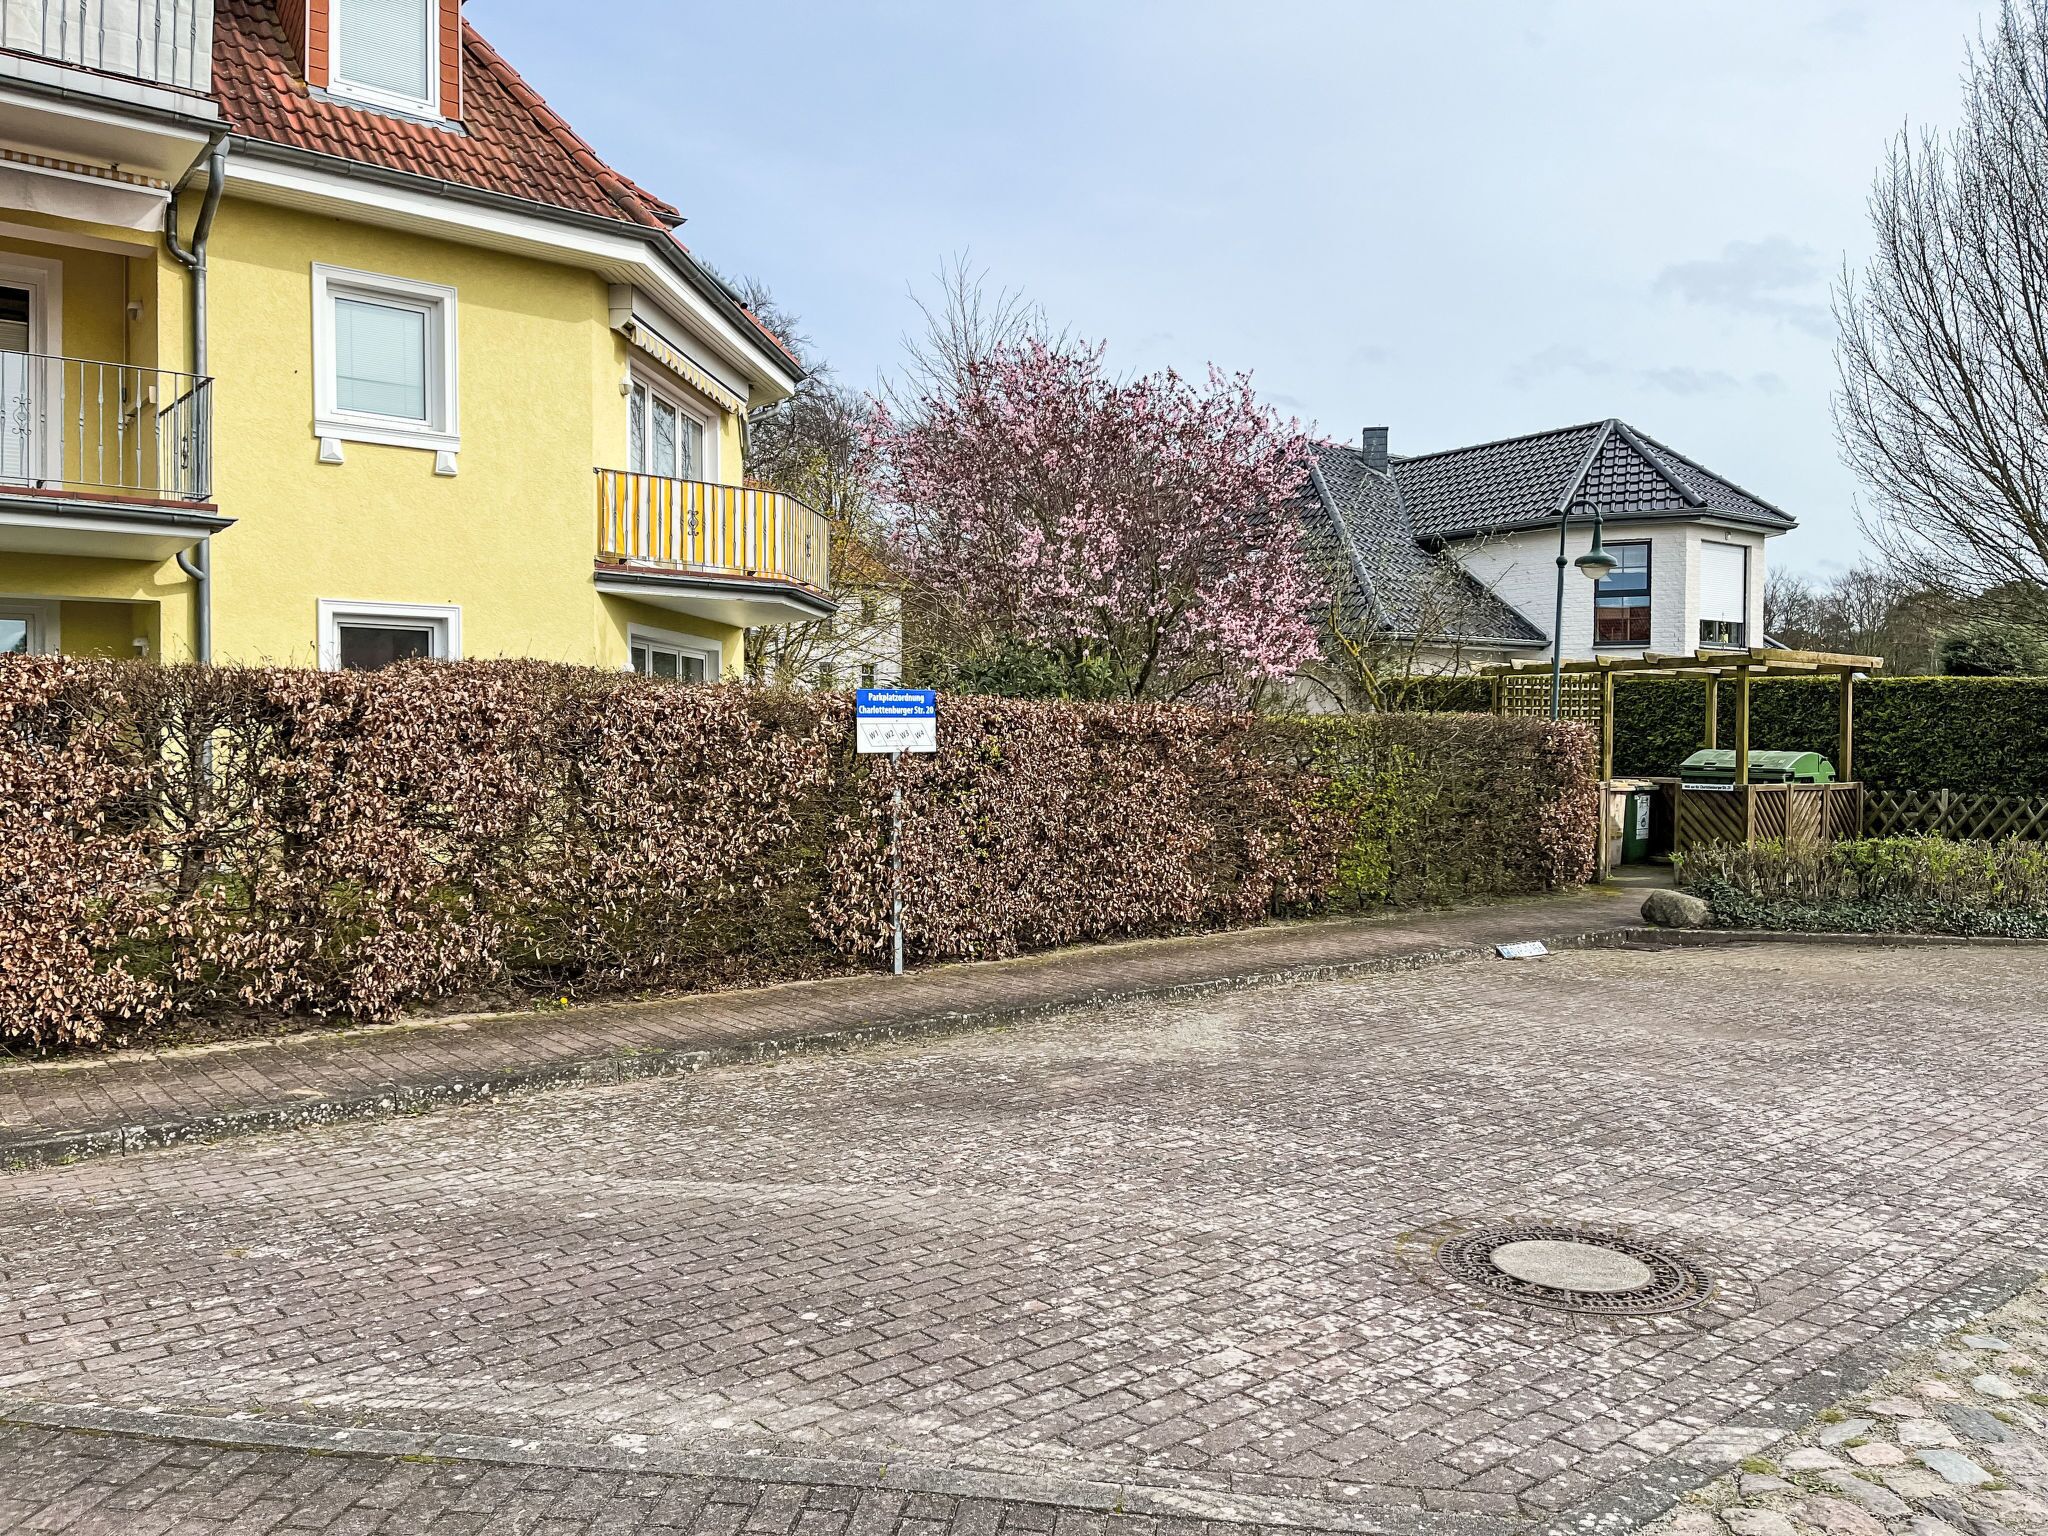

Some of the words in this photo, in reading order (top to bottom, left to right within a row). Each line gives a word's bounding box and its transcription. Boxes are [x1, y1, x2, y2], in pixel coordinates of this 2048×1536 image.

[868, 693, 925, 704] Parkplatzordnung
[858, 705, 914, 716] Charlottenburger
[914, 706, 925, 714] Str.
[926, 706, 934, 714] 20
[868, 730, 879, 740] W1
[884, 729, 895, 739] W2
[899, 729, 910, 739] W3
[914, 730, 925, 739] W4
